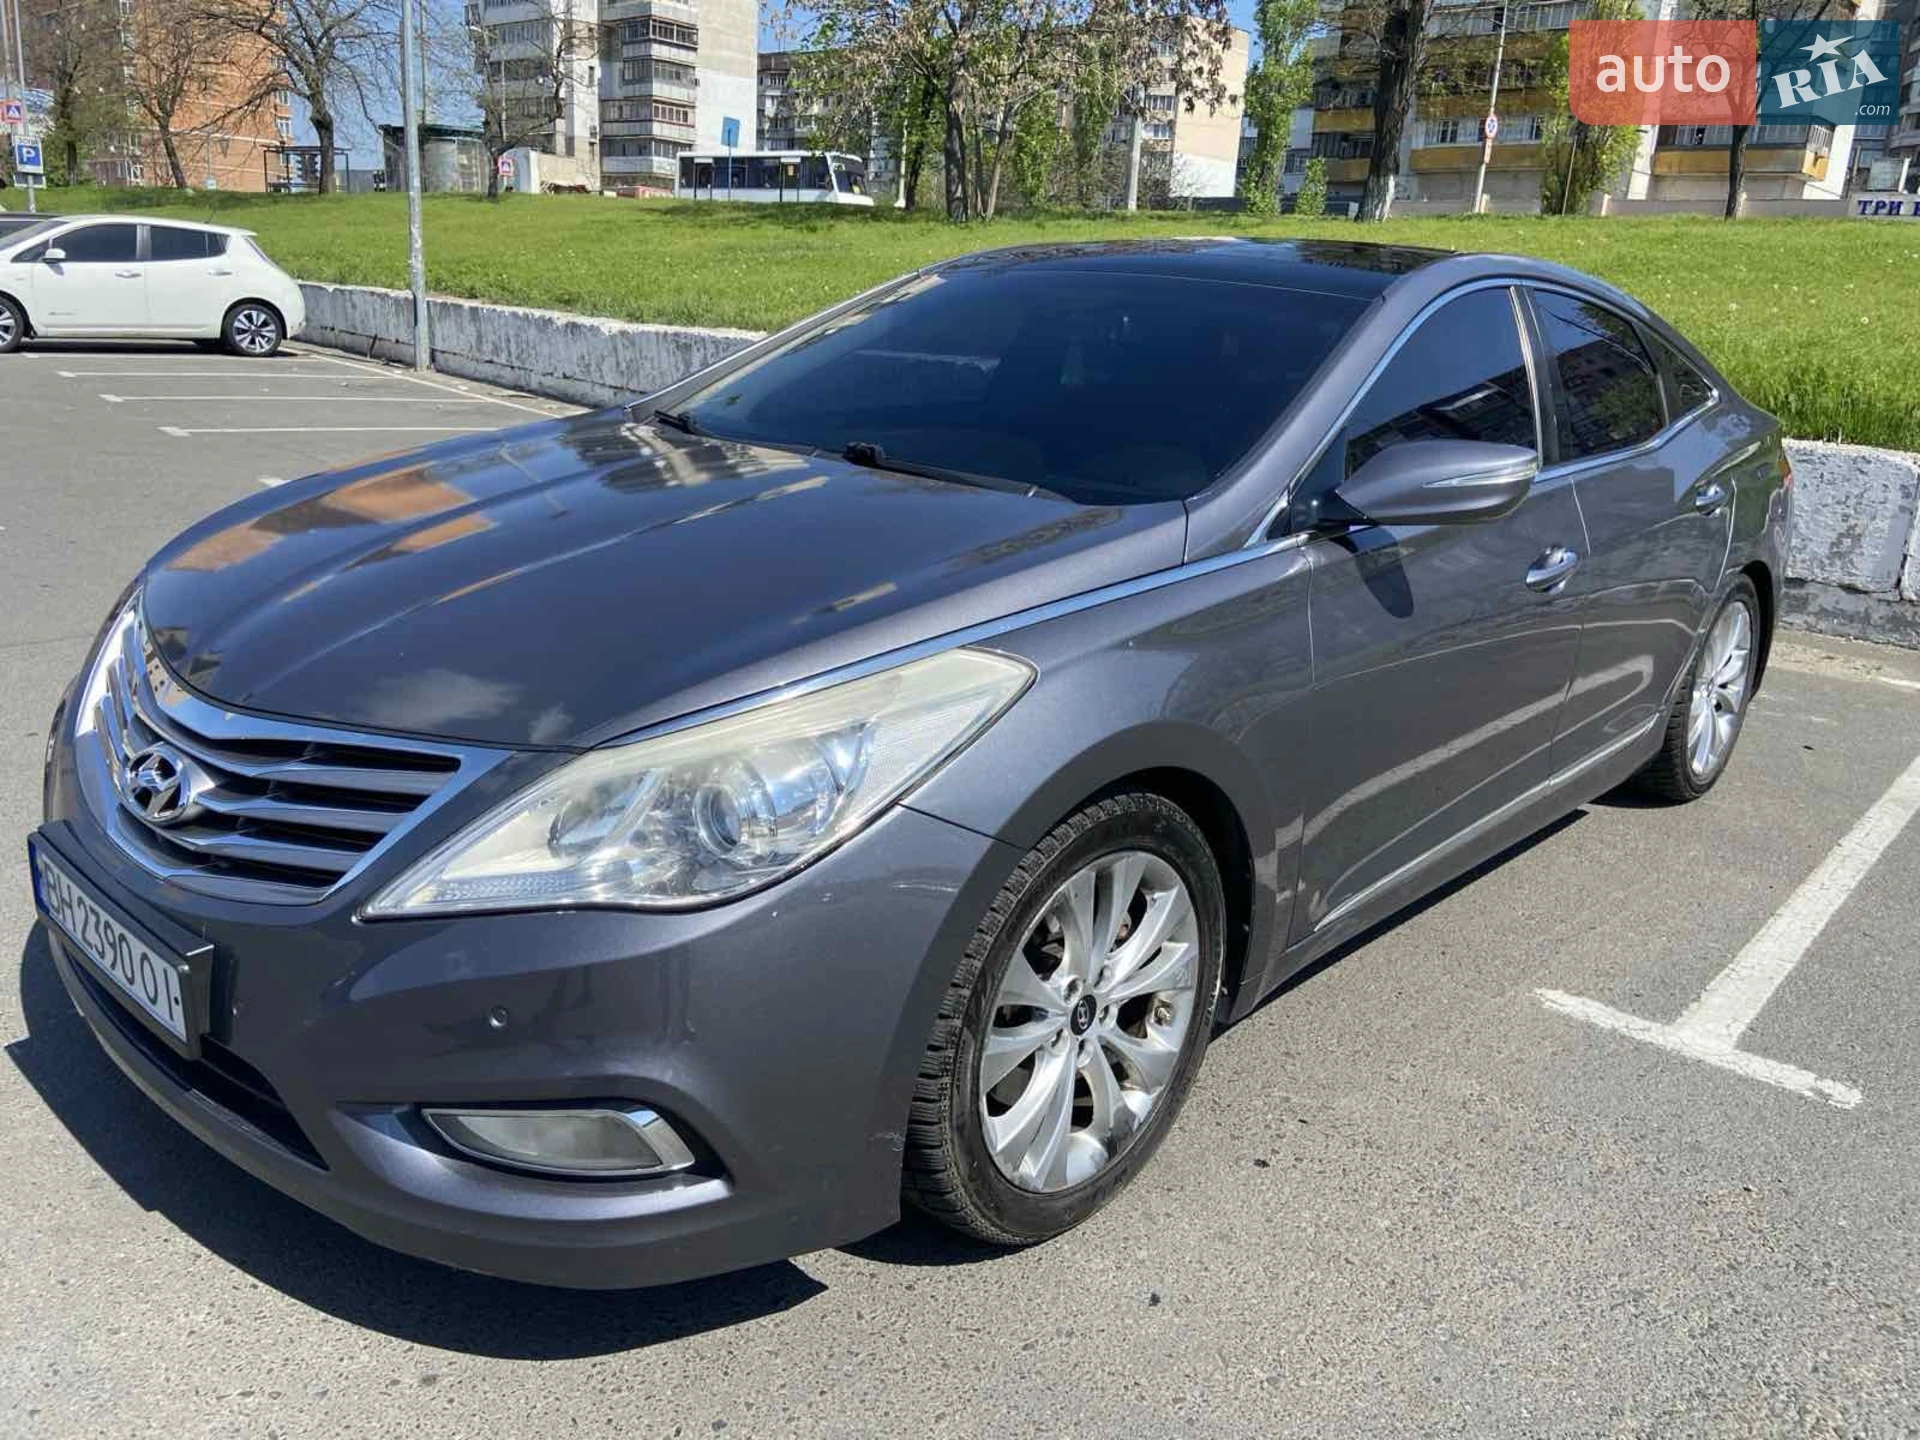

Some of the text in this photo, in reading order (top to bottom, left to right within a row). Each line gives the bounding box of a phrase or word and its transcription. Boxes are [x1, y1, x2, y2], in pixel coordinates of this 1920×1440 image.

[22, 147, 36, 162] P
[44, 862, 174, 1022] BH 2390 OI
